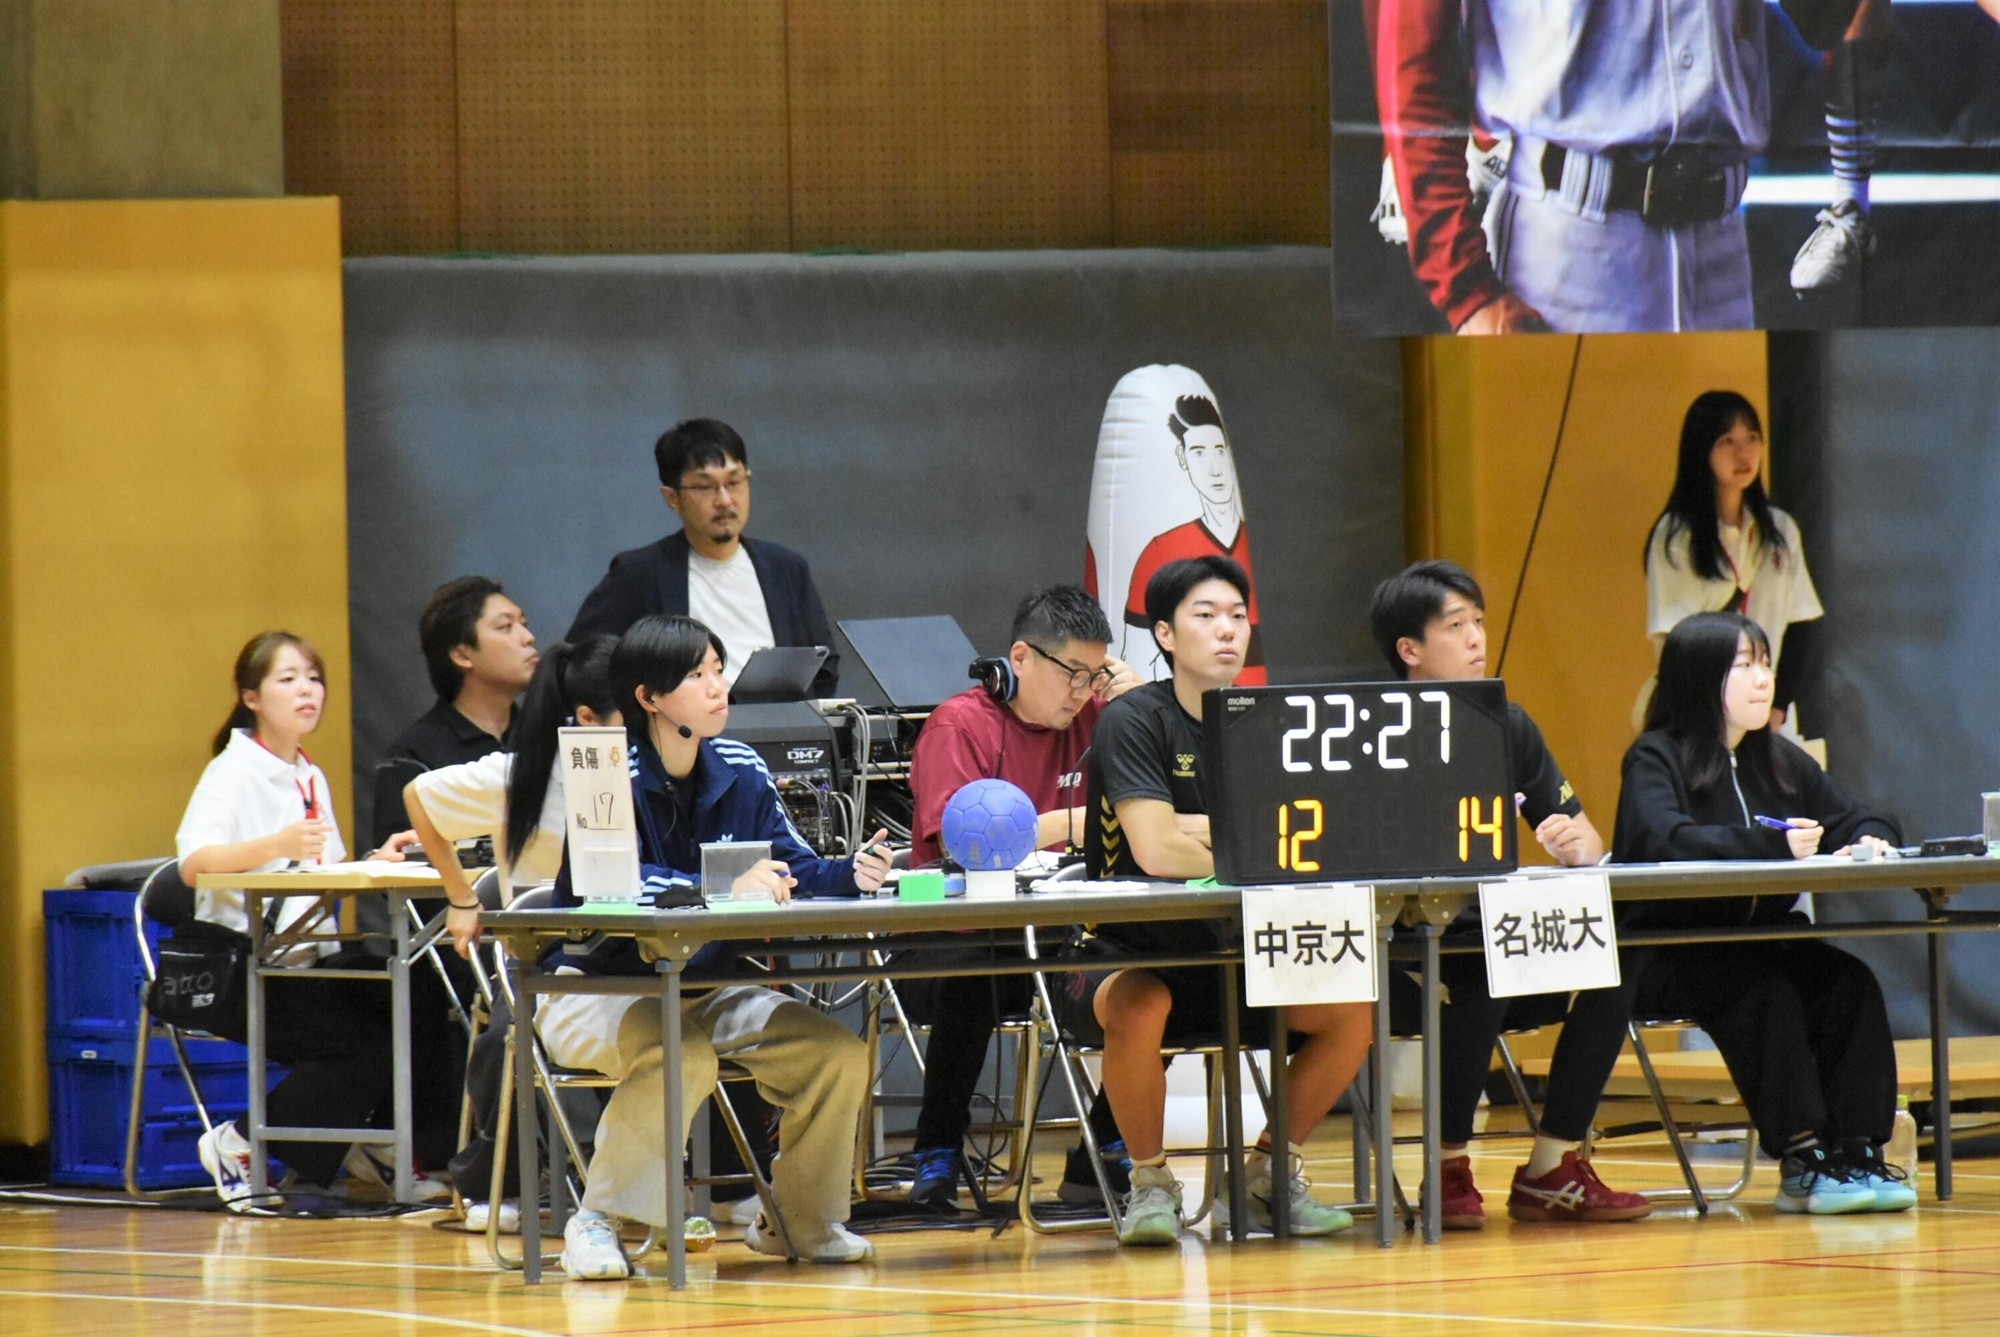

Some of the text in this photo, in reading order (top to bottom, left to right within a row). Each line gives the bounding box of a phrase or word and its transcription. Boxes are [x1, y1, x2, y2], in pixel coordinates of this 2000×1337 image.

[1228, 697, 1255, 706] molten
[787, 750, 824, 760] DM7
[1282, 691, 1450, 772] 22:27
[571, 746, 599, 769] 負傷
[593, 791, 614, 825] 17
[1458, 795, 1503, 862] 14
[1278, 799, 1323, 872] 12
[1253, 920, 1366, 968] 中京大
[1494, 907, 1606, 959] 名城大
